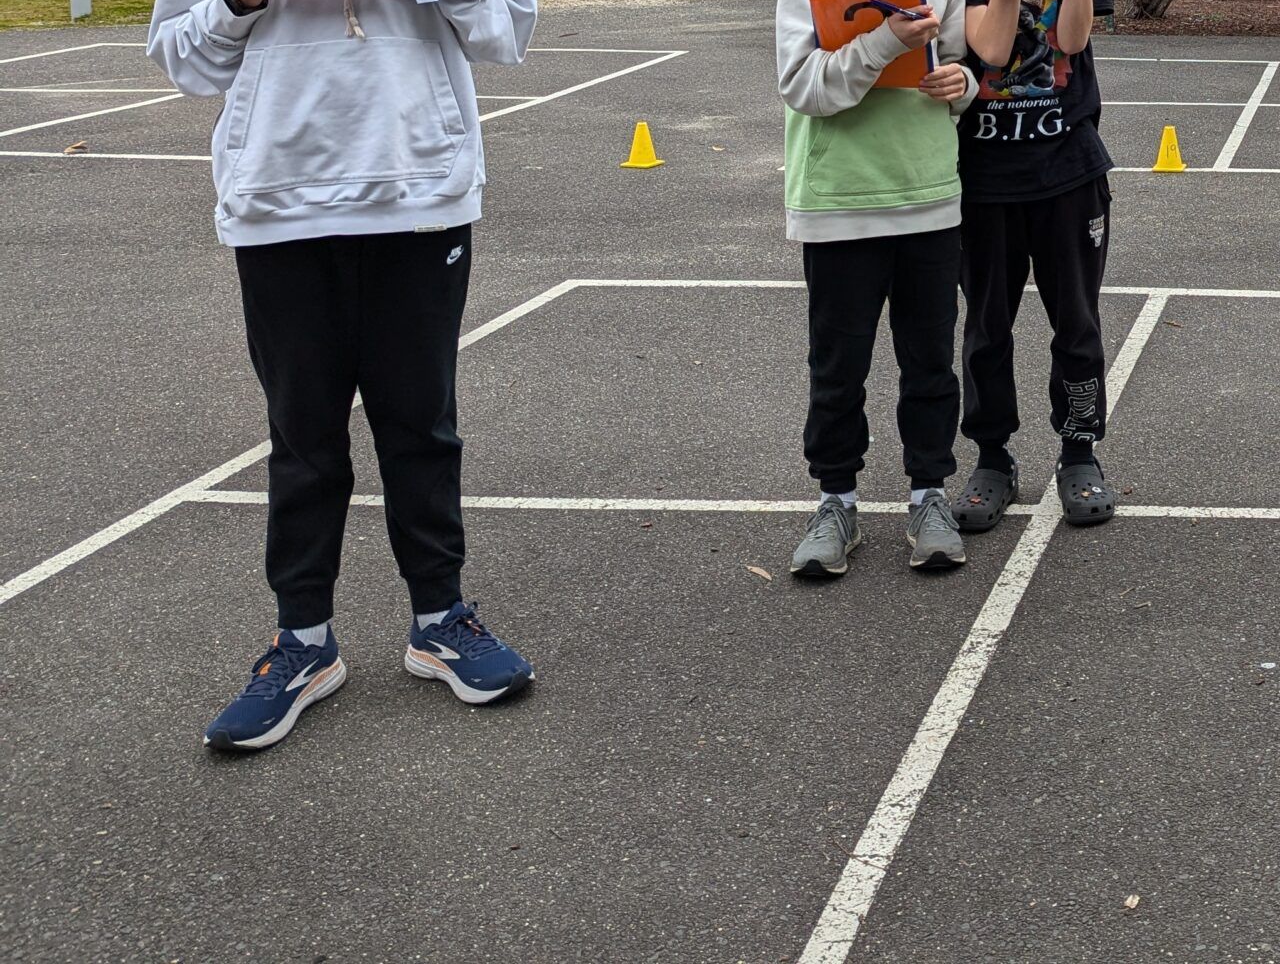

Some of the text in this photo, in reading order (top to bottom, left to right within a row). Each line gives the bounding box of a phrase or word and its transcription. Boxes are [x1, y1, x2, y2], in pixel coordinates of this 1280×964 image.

[986, 96, 1060, 111] the notorious
[972, 107, 1071, 141] B.I.G.
